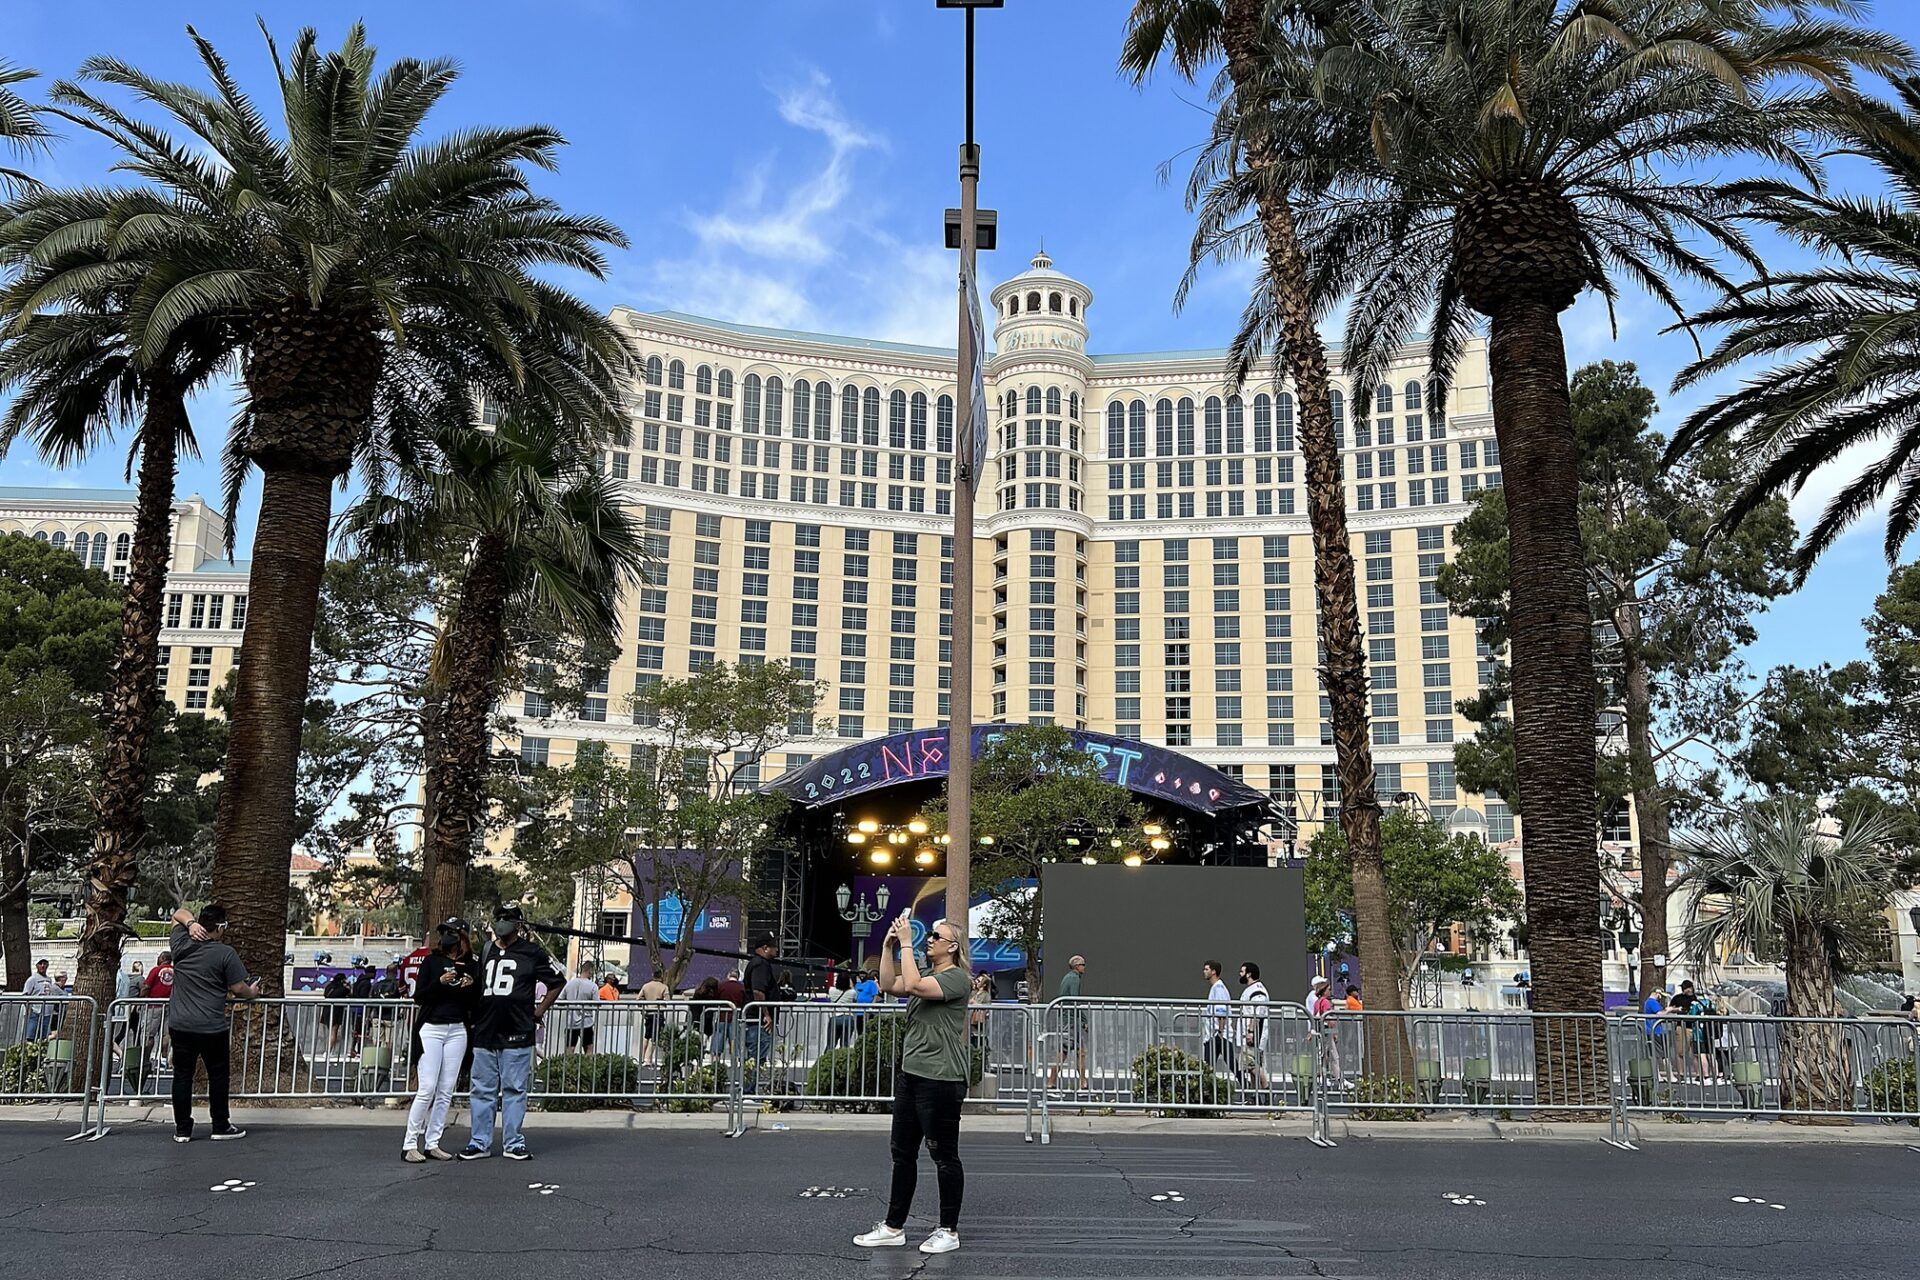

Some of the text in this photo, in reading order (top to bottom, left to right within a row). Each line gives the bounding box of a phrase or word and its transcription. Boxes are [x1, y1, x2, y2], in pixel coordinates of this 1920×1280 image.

[805, 762, 871, 799] 2022
[882, 736, 946, 780] NF
[483, 959, 517, 997] 16
